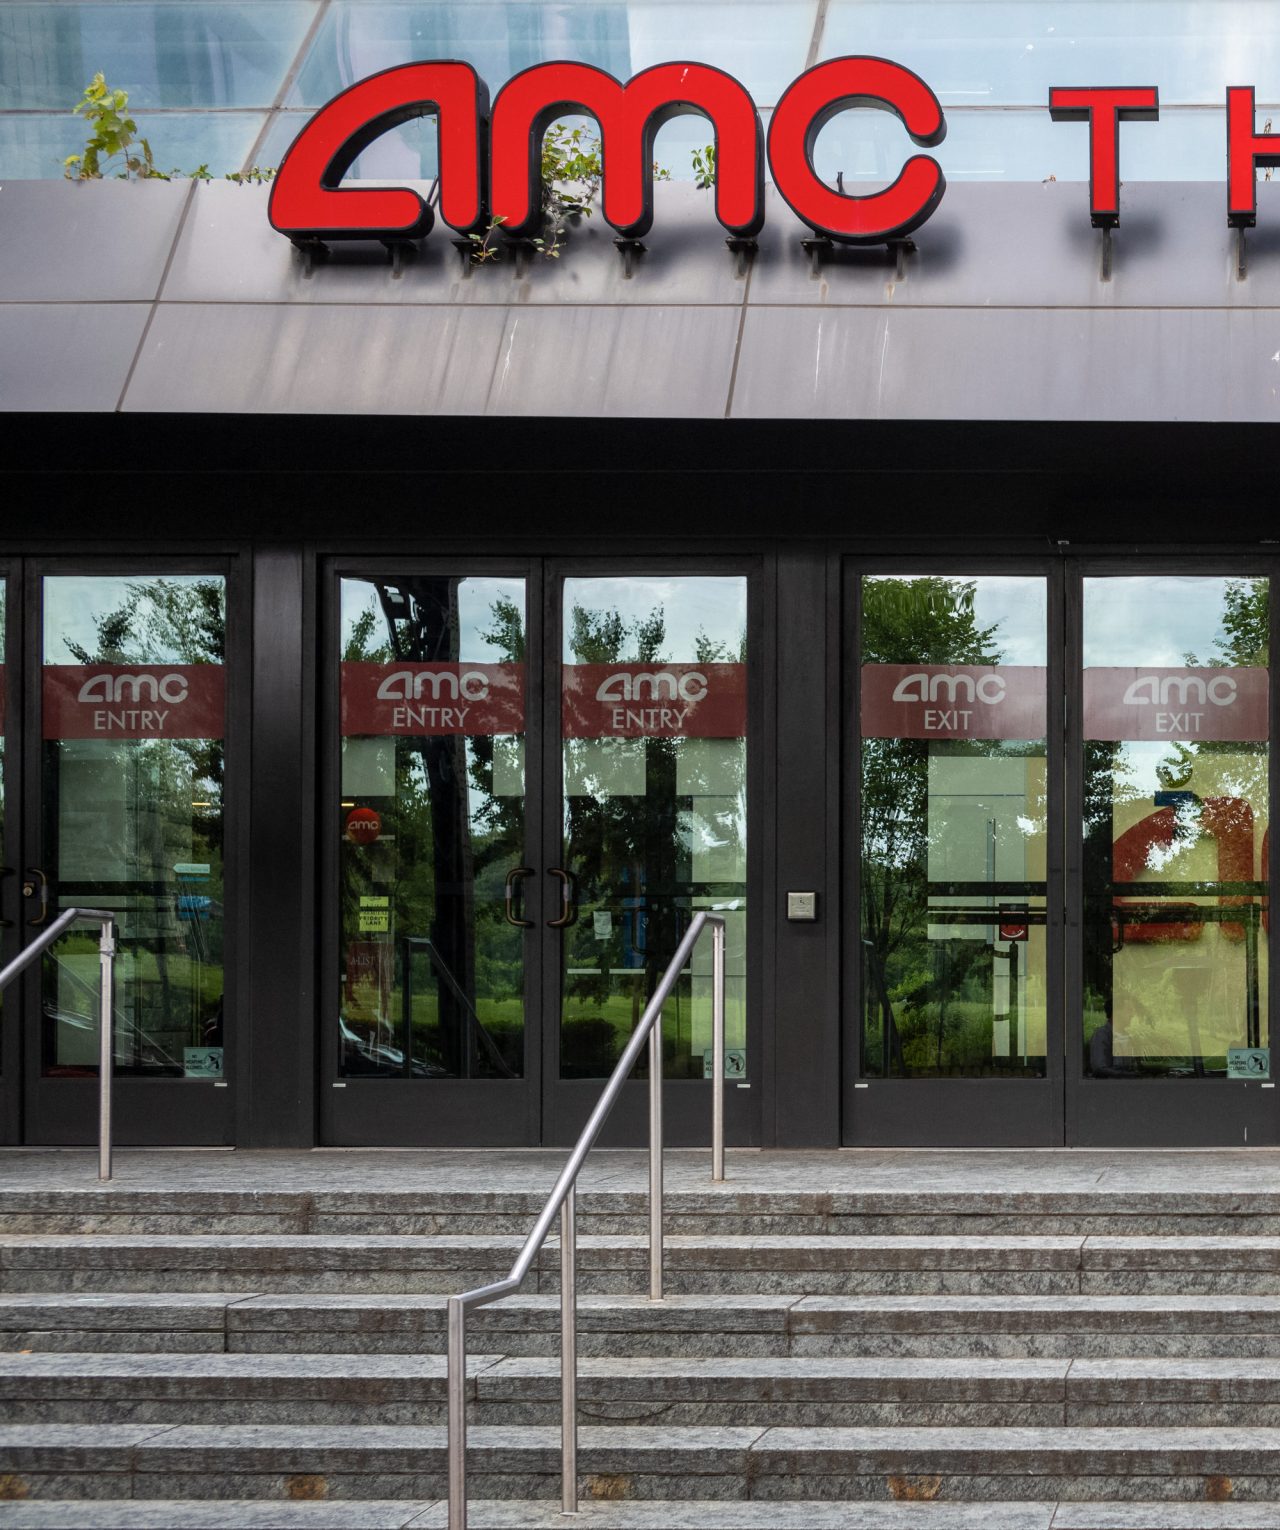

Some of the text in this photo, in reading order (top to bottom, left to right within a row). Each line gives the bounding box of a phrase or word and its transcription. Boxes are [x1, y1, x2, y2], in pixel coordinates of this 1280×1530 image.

[94, 710, 169, 730] ENTRY
[393, 708, 470, 728] ENTRY
[612, 709, 688, 729] ENTRY
[924, 710, 973, 730] EXIT
[1155, 712, 1204, 733] EXIT
